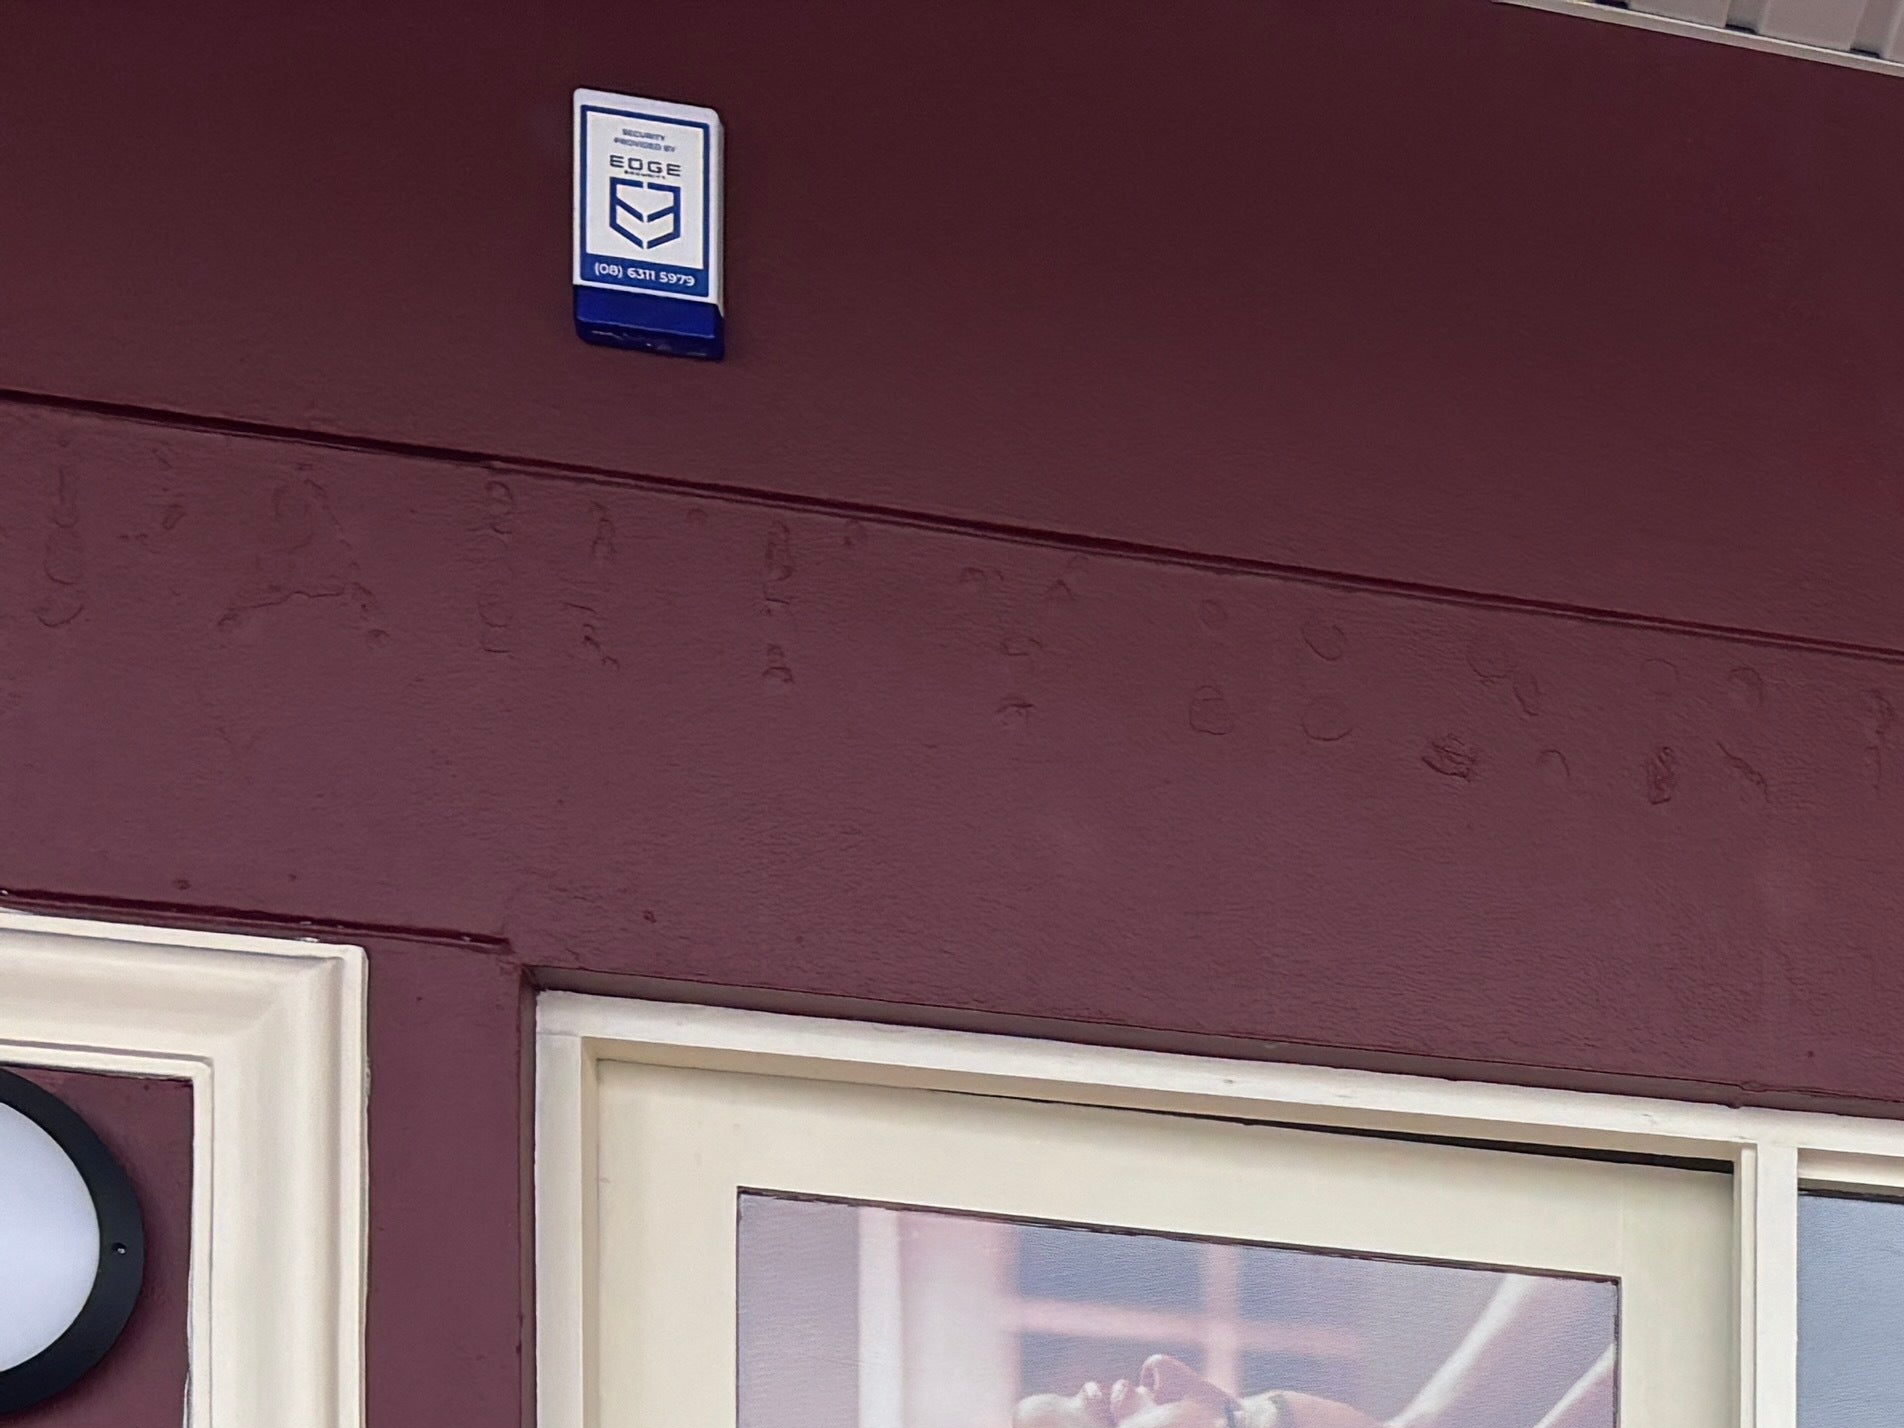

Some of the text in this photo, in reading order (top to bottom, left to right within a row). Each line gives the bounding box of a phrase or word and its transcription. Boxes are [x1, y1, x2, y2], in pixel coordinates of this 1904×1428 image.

[610, 155, 681, 176] EDGE
[594, 262, 695, 286] (08) 6311 5979
